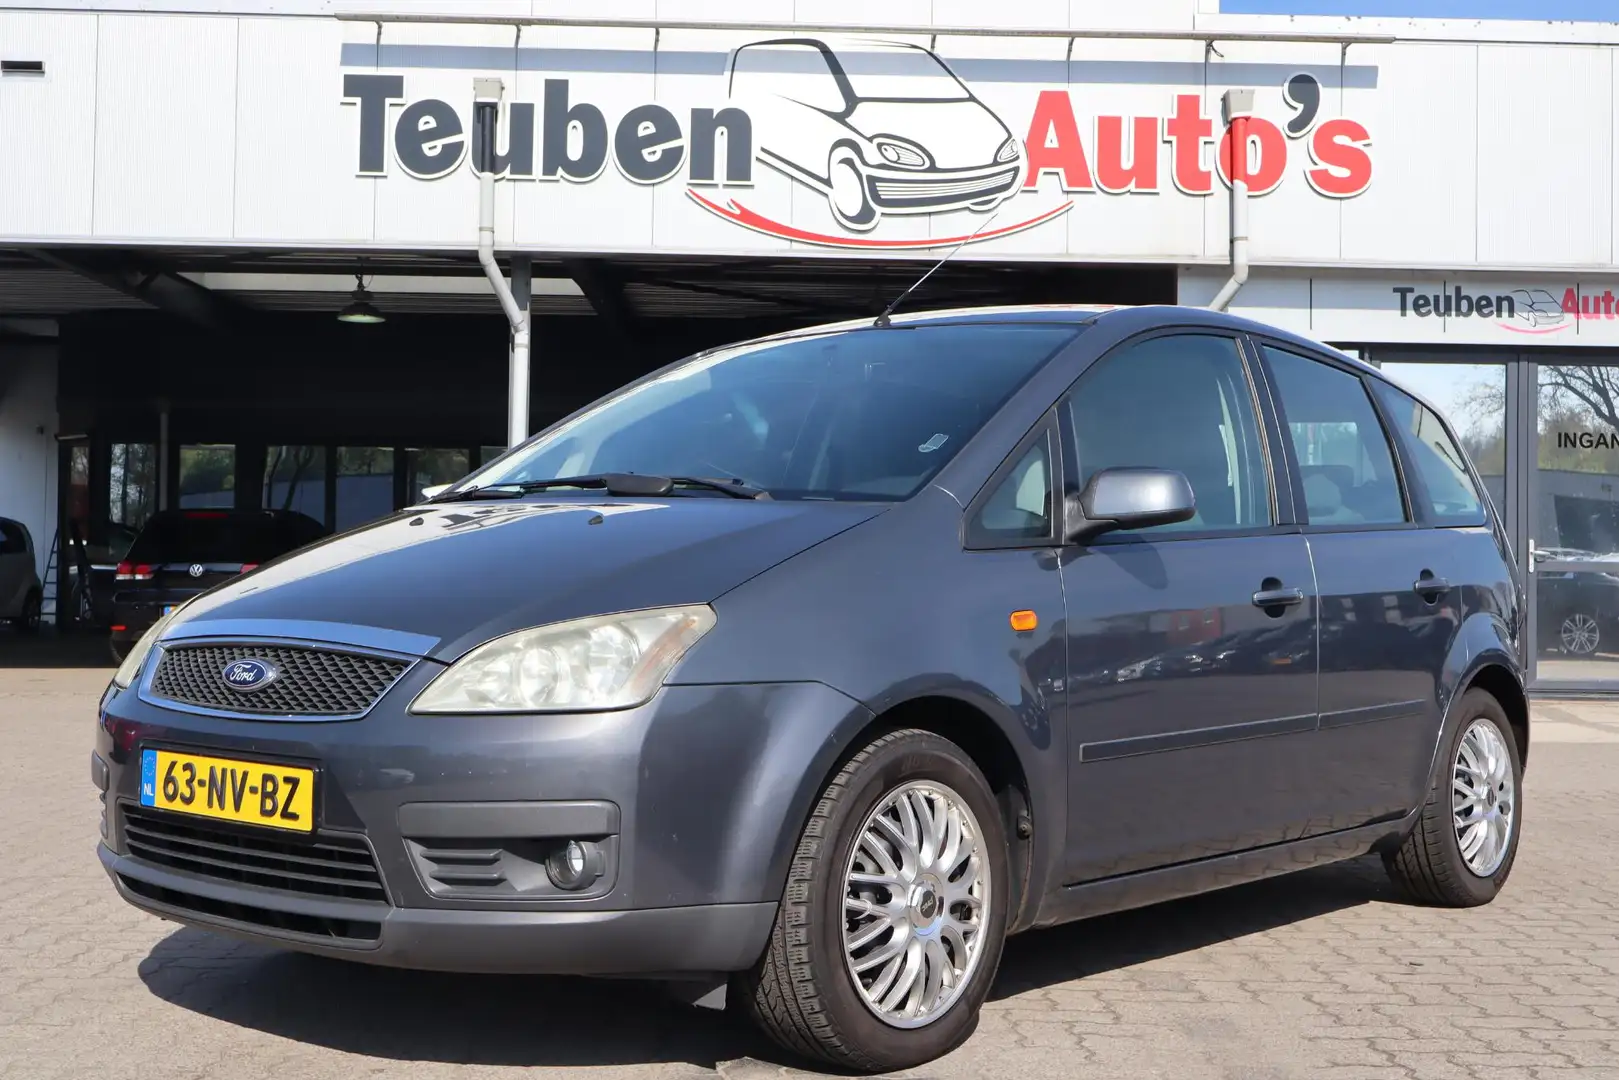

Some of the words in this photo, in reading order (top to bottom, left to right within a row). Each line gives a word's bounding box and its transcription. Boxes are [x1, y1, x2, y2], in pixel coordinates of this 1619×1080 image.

[343, 74, 753, 182] Teuben
[1022, 73, 1373, 195] Auto's
[1392, 285, 1515, 319] Teuben
[1561, 287, 1619, 320] Aut
[229, 663, 258, 682] Ford
[143, 783, 154, 797] NL
[162, 760, 301, 822] 63-NV-BZ
